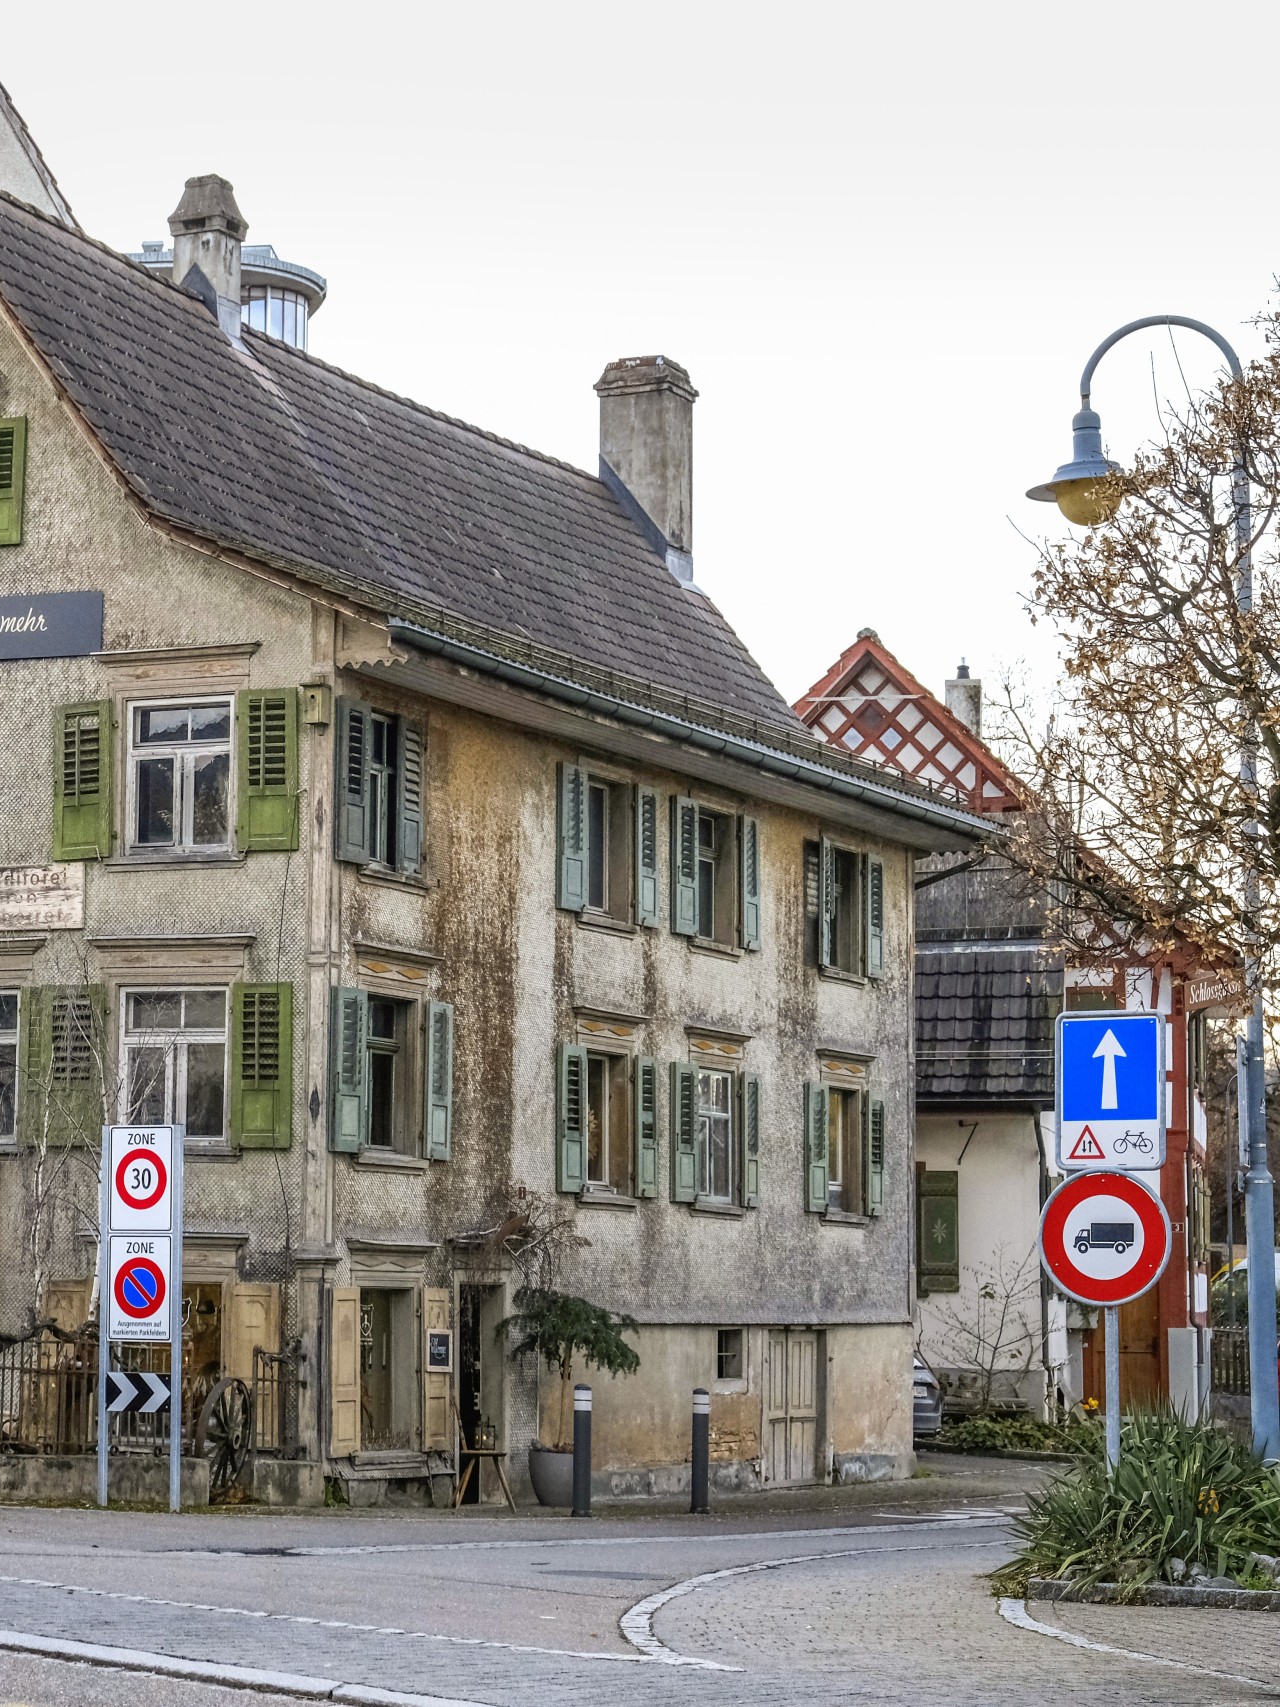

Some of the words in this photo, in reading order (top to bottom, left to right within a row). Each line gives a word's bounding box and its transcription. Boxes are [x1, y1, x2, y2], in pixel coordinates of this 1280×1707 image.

[0, 607, 48, 633] mehr
[127, 1133, 156, 1145] ZONE
[131, 1167, 152, 1190] 30
[126, 1241, 155, 1254] ZONE
[117, 1320, 153, 1329] Ausgenommen
[153, 1320, 162, 1328] auf
[112, 1329, 139, 1337] markierten
[139, 1329, 167, 1337] Parkfeldern
